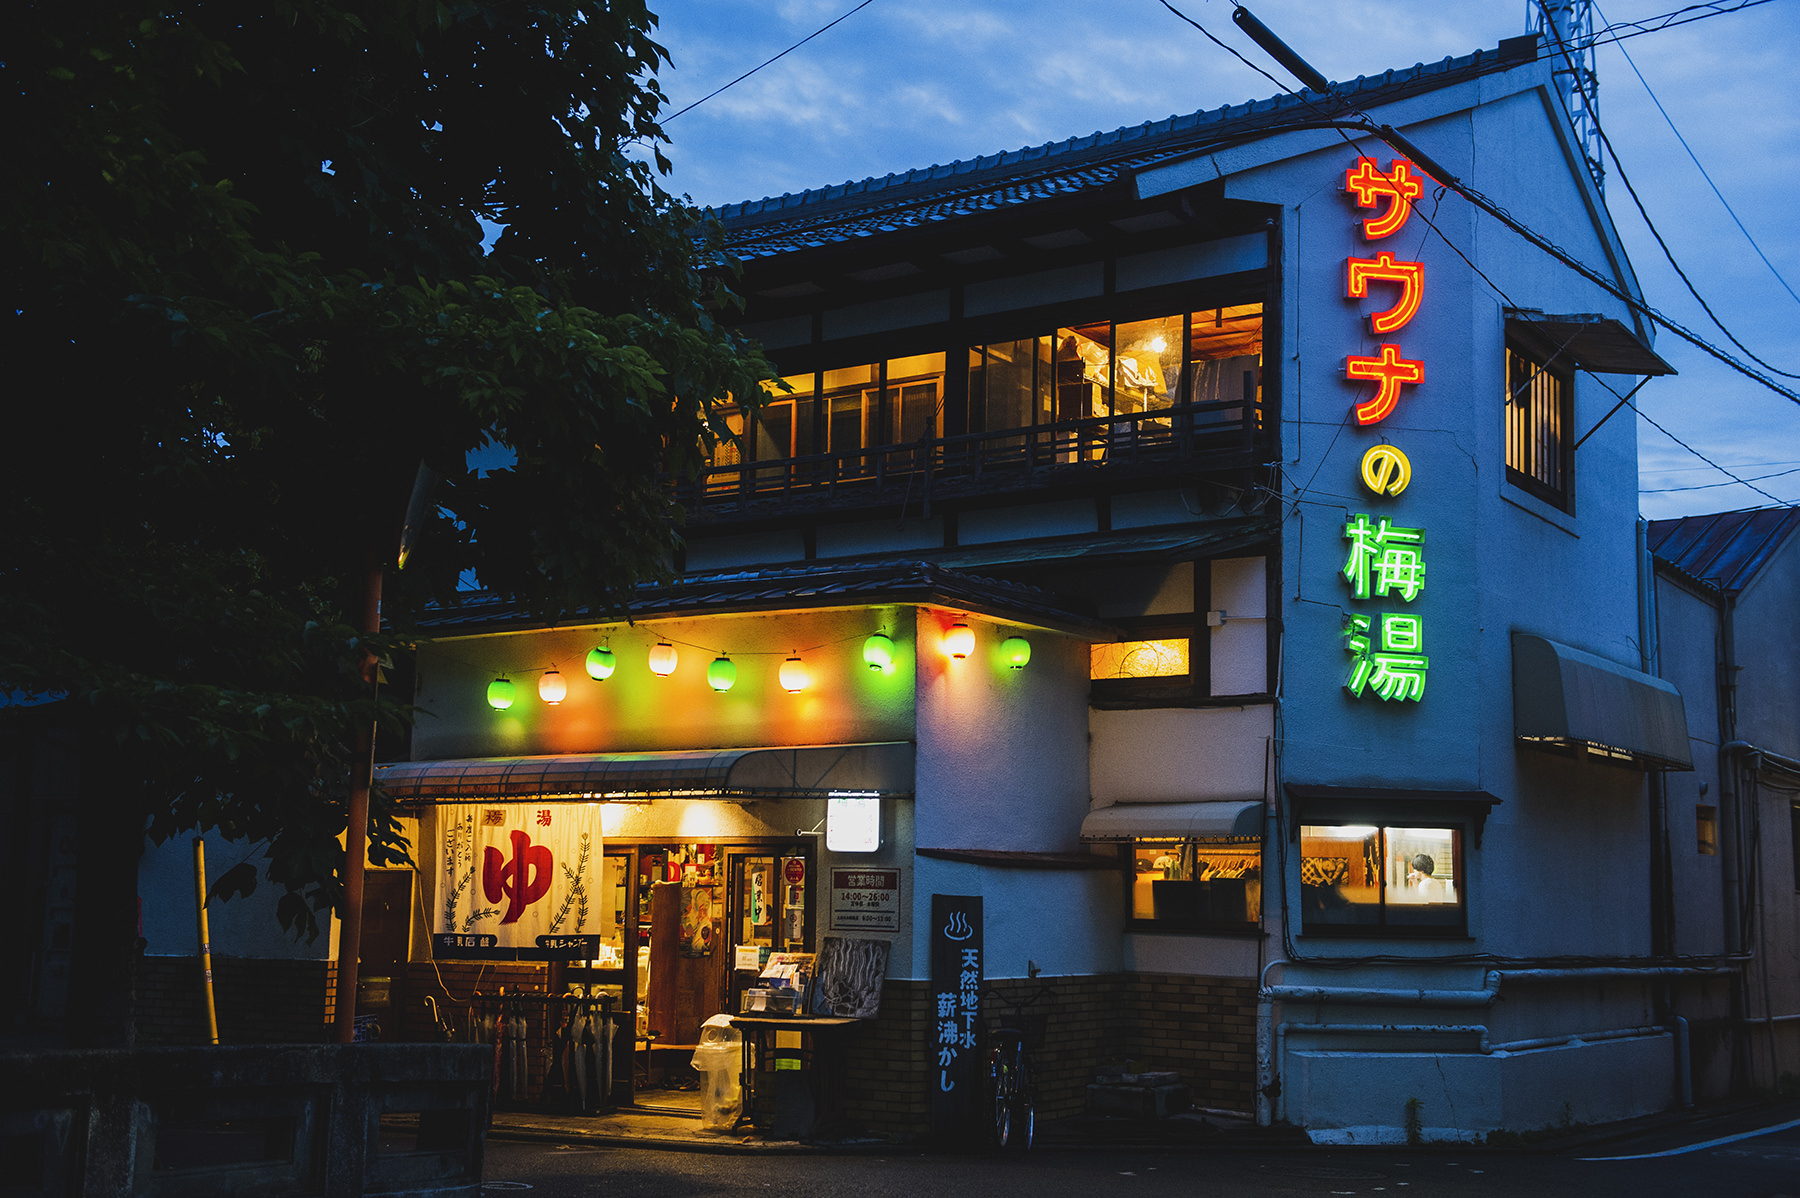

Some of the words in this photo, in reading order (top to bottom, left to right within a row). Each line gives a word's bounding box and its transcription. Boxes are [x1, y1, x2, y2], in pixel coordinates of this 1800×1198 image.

[1344, 156, 1427, 703] サウナの梅湯
[445, 829, 455, 877] ございます
[536, 809, 552, 827] 湯
[483, 830, 554, 926] ゆ
[754, 873, 763, 921] 営業中
[847, 874, 885, 887] 営業時間
[959, 948, 979, 1049] 天然地下水
[937, 992, 958, 1093] 薪沸かし
